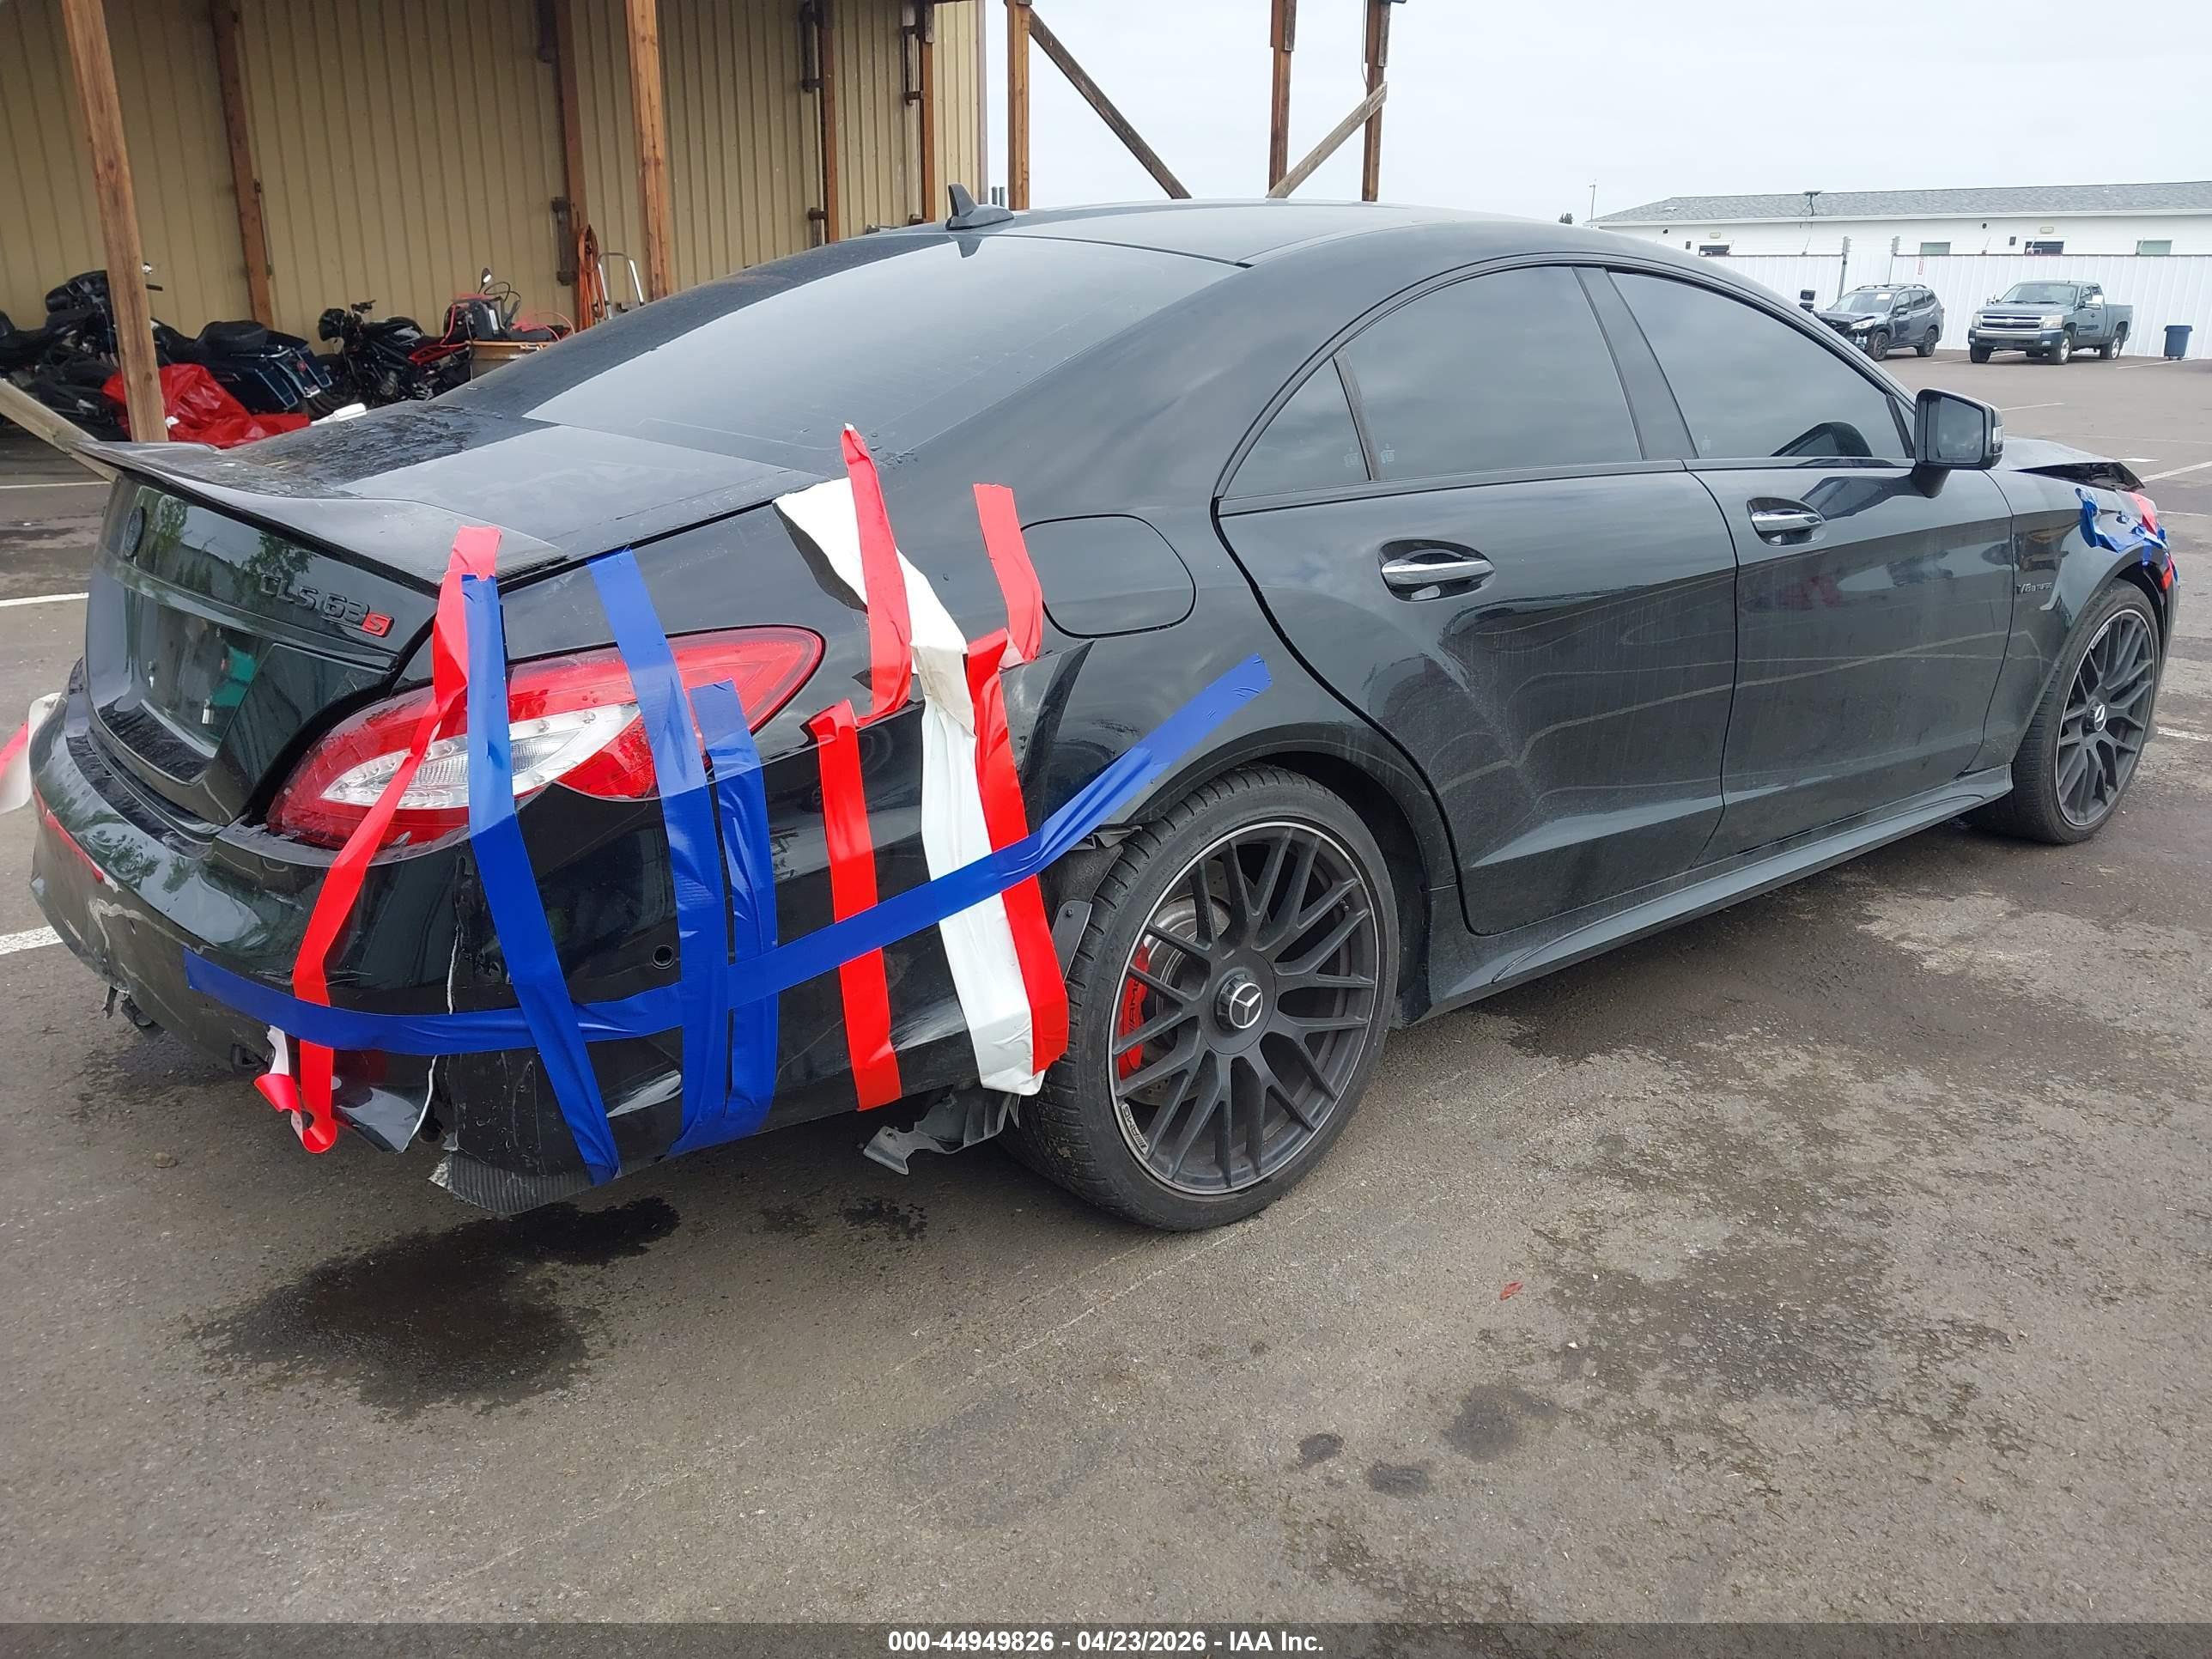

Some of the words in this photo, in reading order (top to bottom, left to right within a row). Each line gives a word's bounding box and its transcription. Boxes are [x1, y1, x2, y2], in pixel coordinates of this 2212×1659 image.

[260, 574, 319, 611] CLS
[322, 592, 370, 625] 63
[362, 614, 392, 635] S
[1122, 1105, 1141, 1138] AMG
